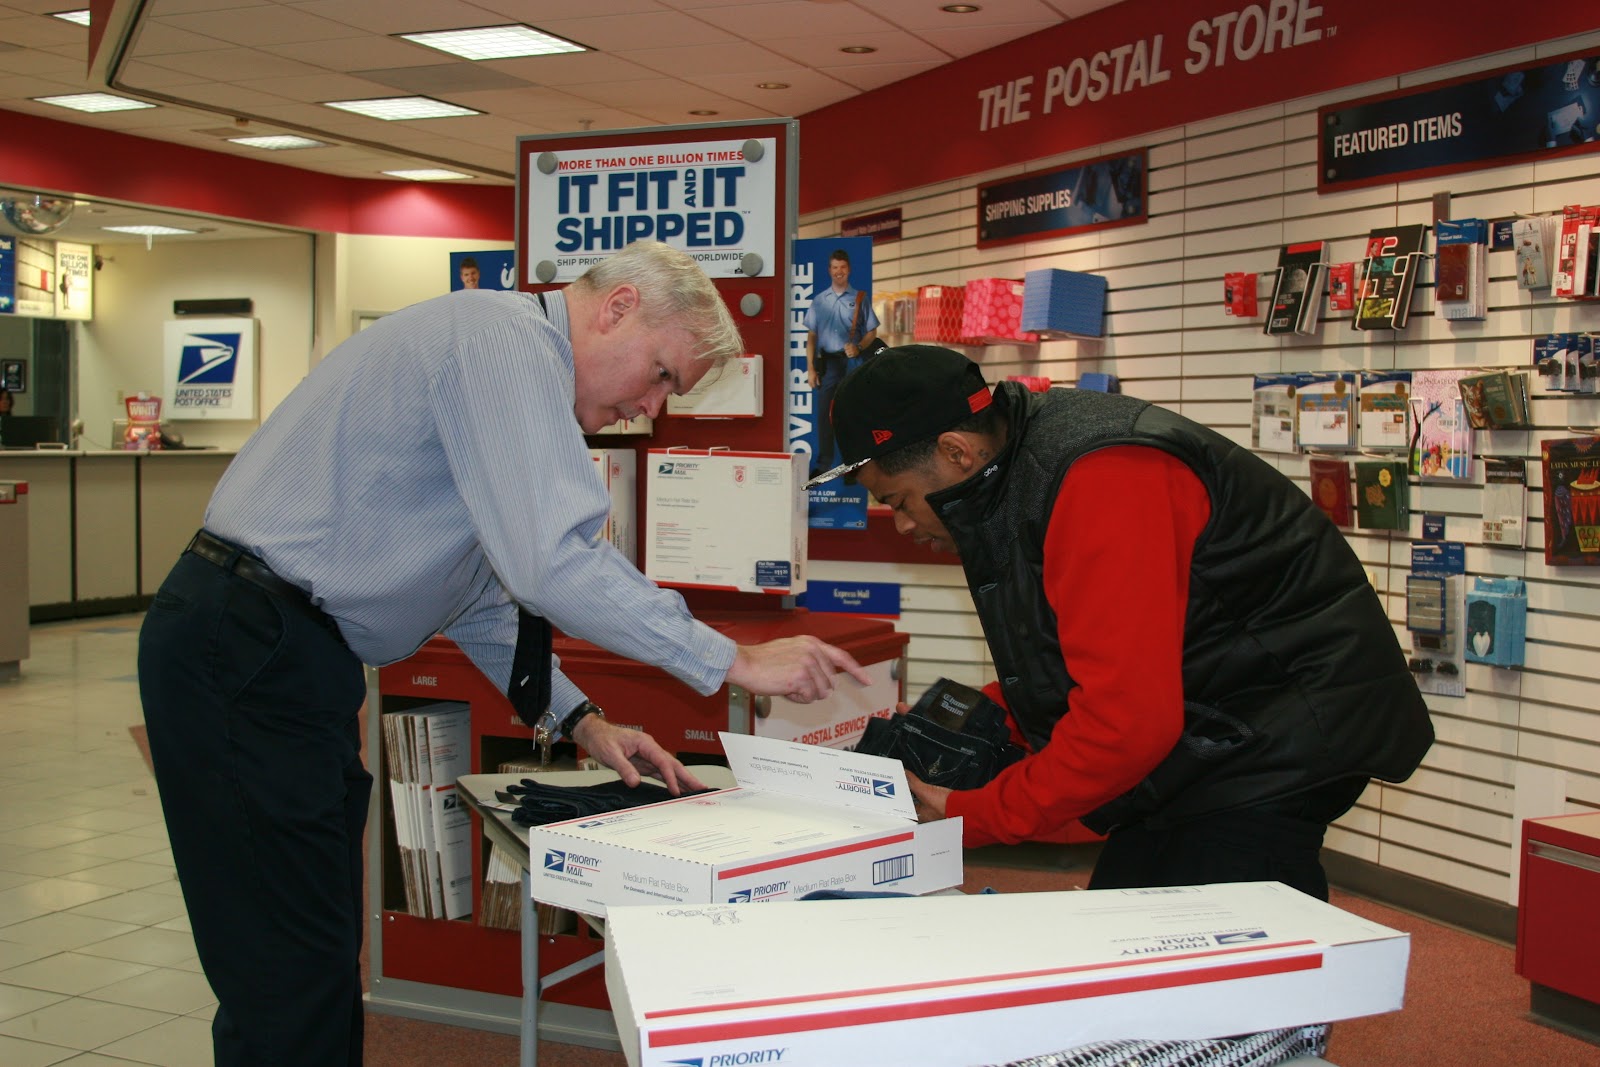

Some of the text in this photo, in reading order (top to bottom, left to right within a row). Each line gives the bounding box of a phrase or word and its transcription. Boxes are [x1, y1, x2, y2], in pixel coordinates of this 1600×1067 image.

[978, 75, 1034, 131] THE
[1043, 34, 1171, 114] POSTAL
[1184, 0, 1324, 75] STORE
[1334, 112, 1462, 158] FEATURED ITEMS
[558, 150, 745, 170] MORE THAN ONE BILLION TIMES
[558, 166, 745, 214] IT FIT AND IT
[985, 189, 1071, 222] SHIPPING SUPPLIES
[555, 211, 744, 253] SHIPPED
[557, 258, 577, 267] SHIP
[791, 262, 814, 357] HERE
[176, 388, 232, 398] UNITED STATES
[174, 398, 220, 406] POST OFFICE
[1550, 461, 1568, 469] LATIN
[412, 675, 438, 686] LARGE
[684, 729, 716, 742] SMALL
[801, 727, 833, 745] POSTAL
[834, 716, 866, 738] SERVICE
[851, 774, 870, 785] MAIL
[837, 782, 872, 795] PRIORITY
[567, 852, 600, 867] PRIORITY
[565, 865, 583, 877] MAIL
[622, 872, 690, 893] Medium Flat Rate Box
[753, 880, 789, 897] PRIORITY
[793, 873, 857, 895] Medium Flat Rate Box
[1154, 935, 1206, 945] MAIL
[1119, 941, 1211, 956] PRIORITY
[709, 1047, 786, 1067] PRIORITY
